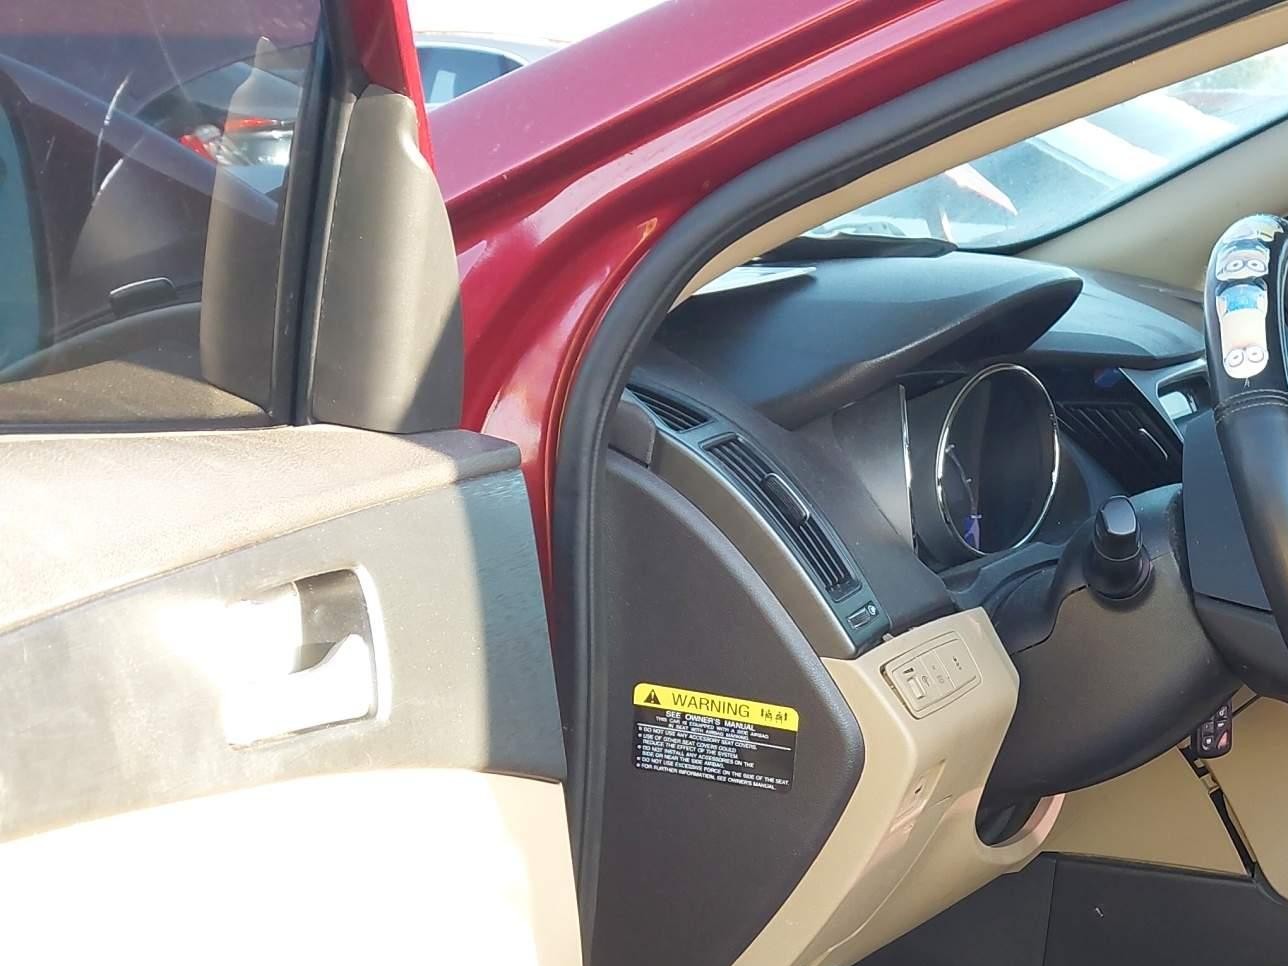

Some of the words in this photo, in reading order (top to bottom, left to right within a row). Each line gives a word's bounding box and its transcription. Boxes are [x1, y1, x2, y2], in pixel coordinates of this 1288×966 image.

[672, 691, 749, 718] WARNING
[665, 710, 681, 719] SEE
[685, 713, 720, 725] OWNER'S
[724, 720, 756, 731] MANUAL
[688, 734, 719, 743] ACCESSORY
[653, 764, 677, 773] FURTHER
[703, 766, 721, 774] FORCE
